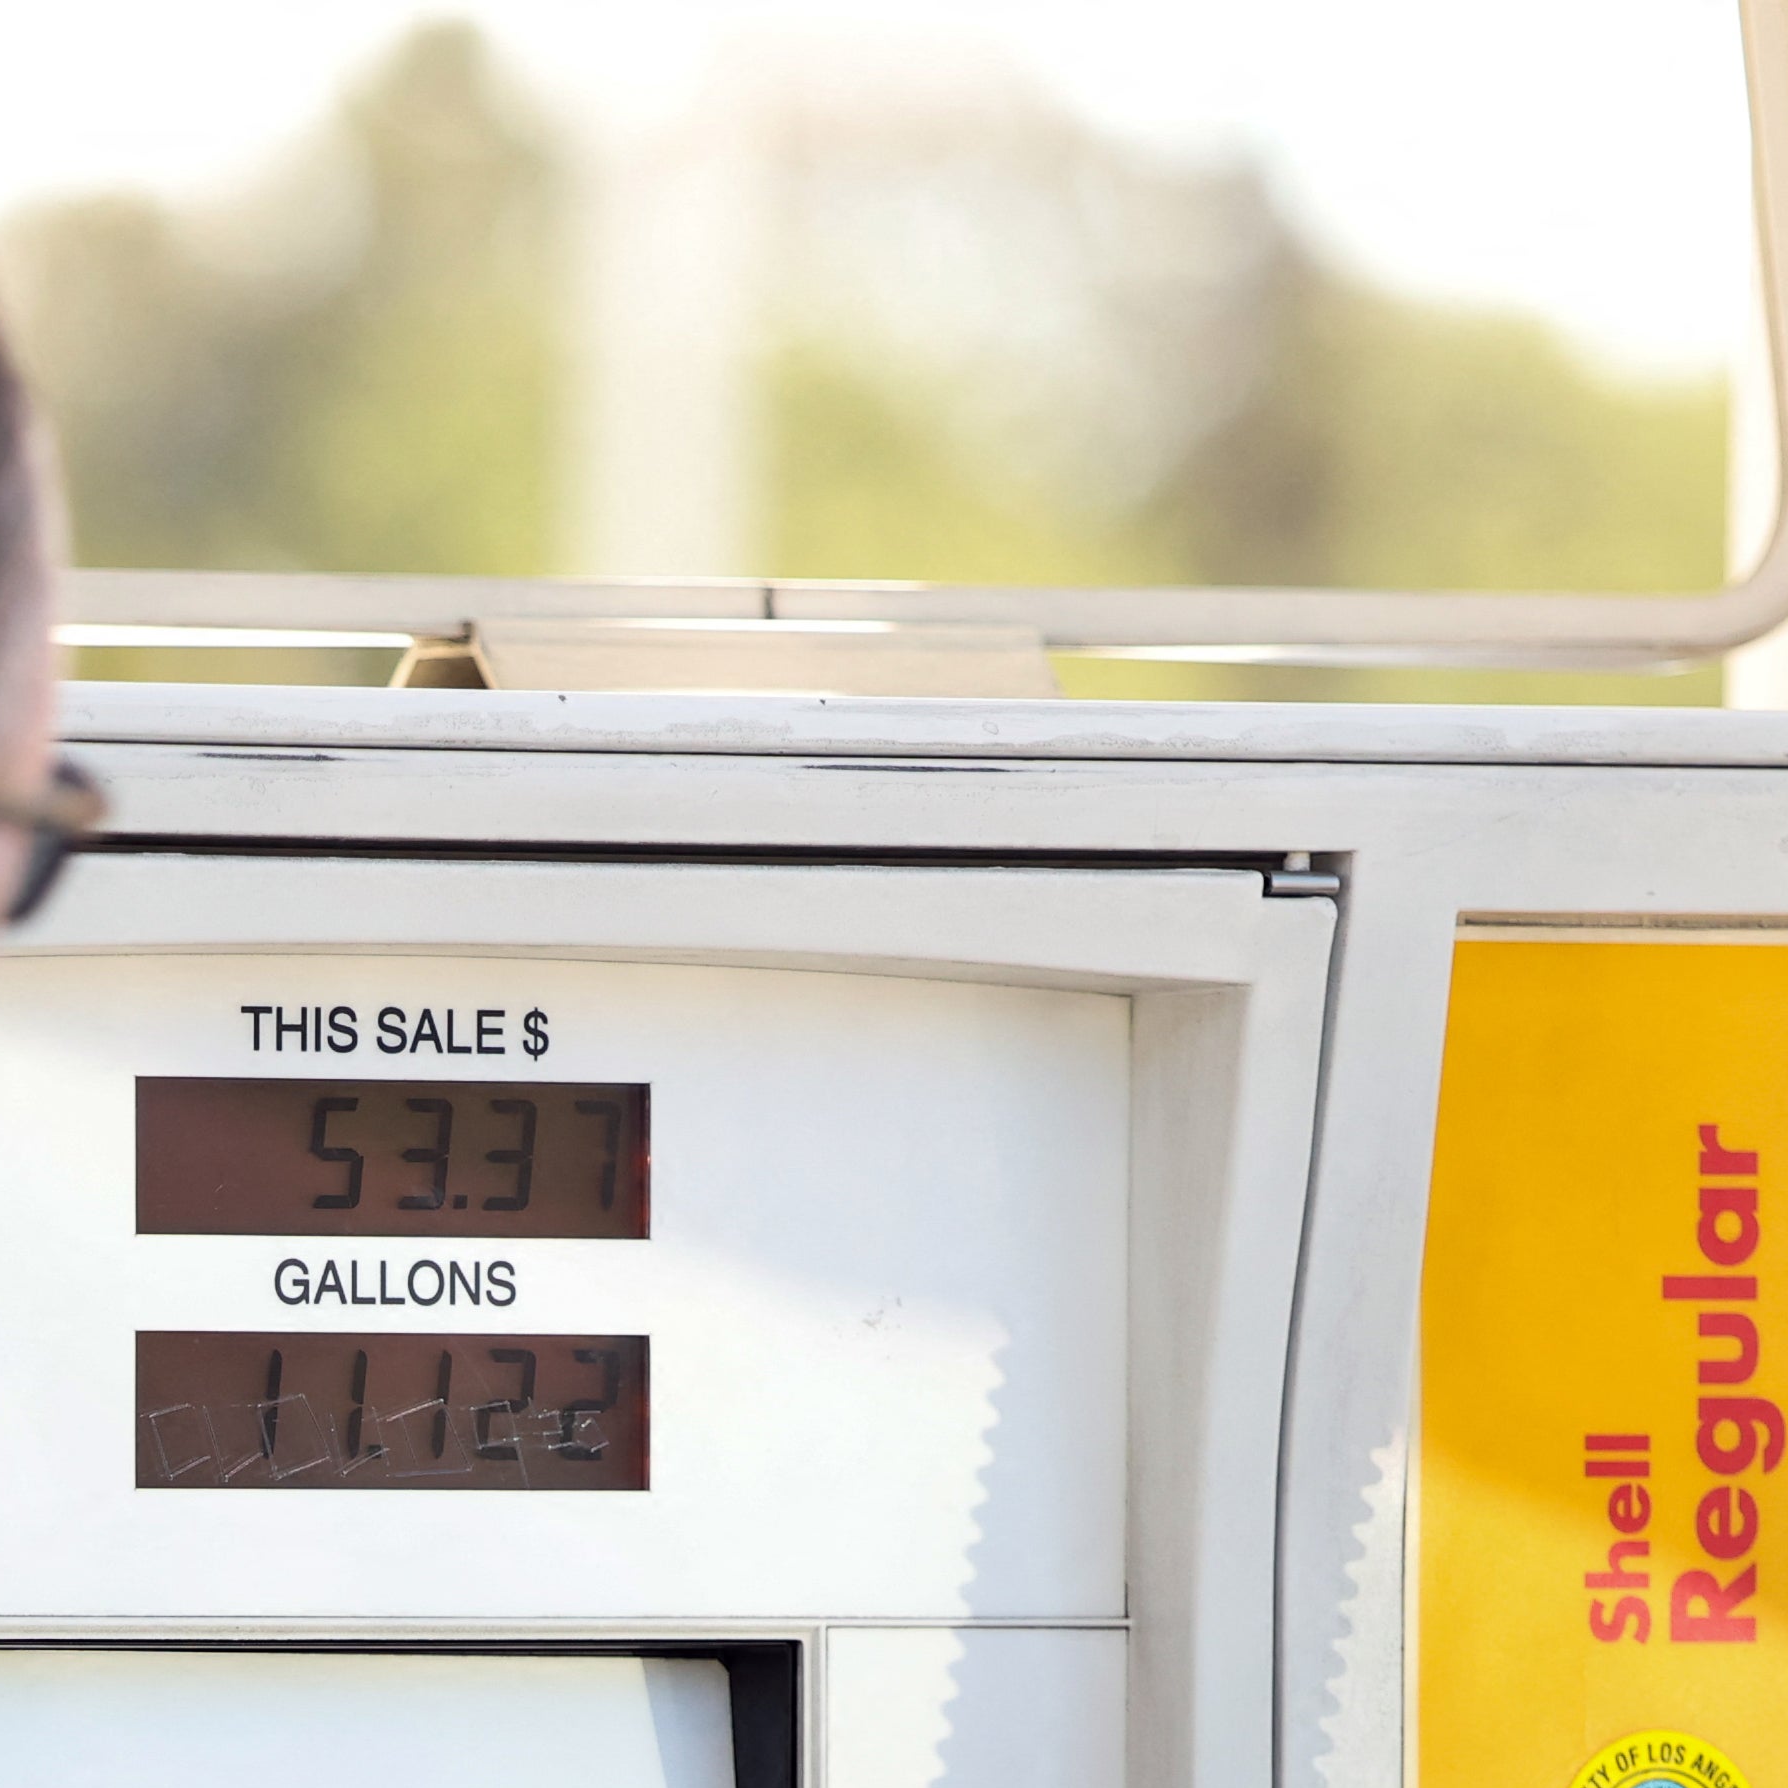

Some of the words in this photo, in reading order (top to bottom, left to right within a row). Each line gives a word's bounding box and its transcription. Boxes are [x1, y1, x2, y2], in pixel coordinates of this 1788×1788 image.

[241, 1006, 358, 1053] THIS
[376, 1007, 506, 1054] SALE
[522, 1007, 550, 1061] $
[309, 1097, 622, 1211] 53.37
[274, 1259, 516, 1306] GALLONS
[1662, 1125, 1786, 1644] Regular
[1584, 1434, 1650, 1644] Shell
[1615, 1746, 1640, 1773] OF
[1647, 1742, 1687, 1765] LOS
